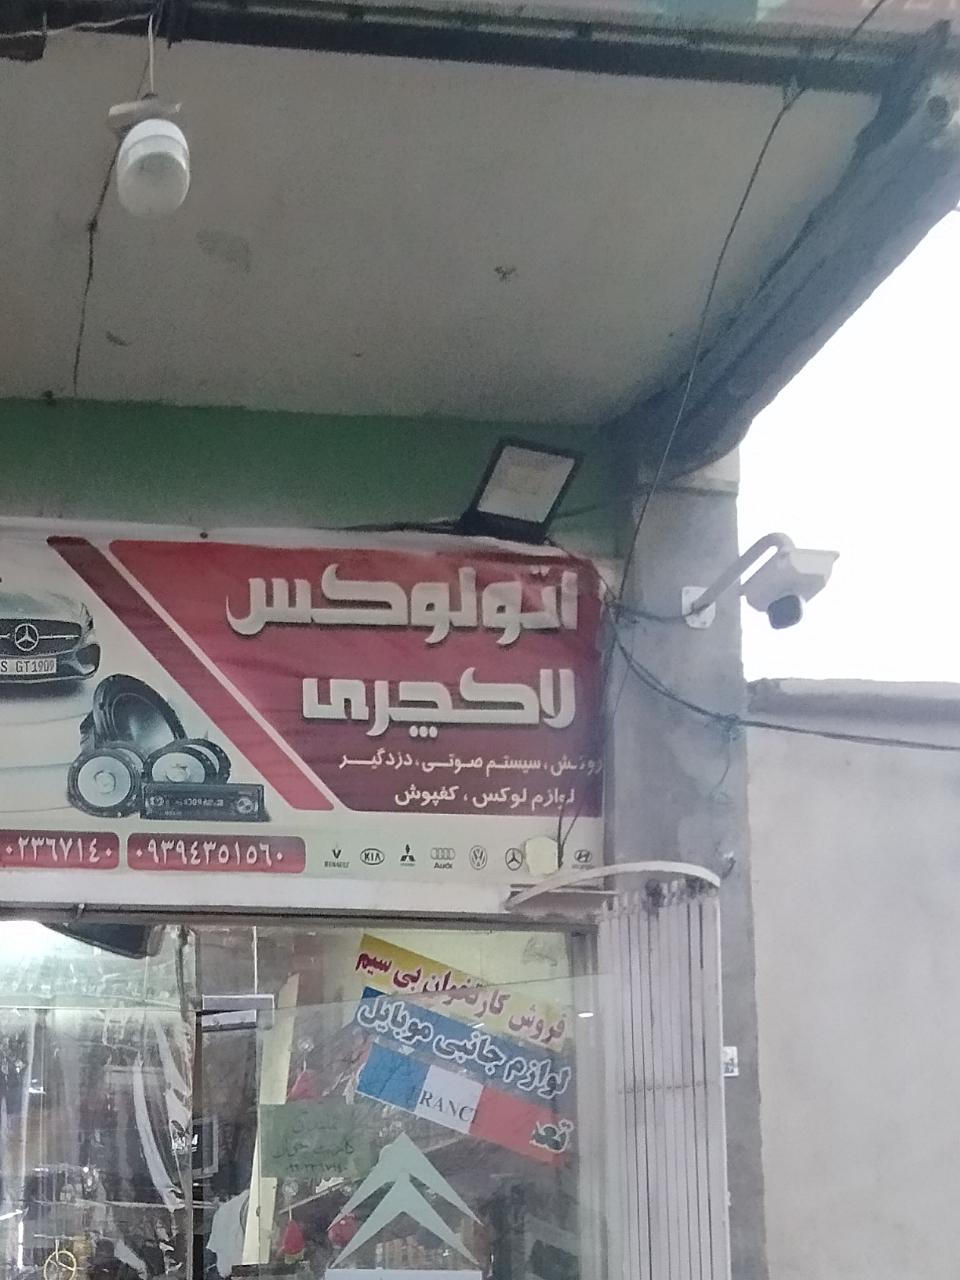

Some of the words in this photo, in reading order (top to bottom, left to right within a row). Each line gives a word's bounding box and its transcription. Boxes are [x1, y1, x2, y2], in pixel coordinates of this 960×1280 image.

[225, 563, 579, 647] اتولوکس
[301, 666, 576, 739] لاکچری
[339, 748, 413, 770] دزدگیر
[486, 755, 541, 777] سیستم
[394, 784, 460, 807] کفپوش
[531, 788, 575, 811] لوازم
[433, 860, 453, 870] Audi
[355, 952, 393, 976] سیم
[392, 967, 422, 991] بی
[356, 995, 435, 1044] موبایل
[508, 1004, 568, 1045] فروش
[432, 1030, 506, 1075] جانبی
[503, 1056, 572, 1099] لوازم
